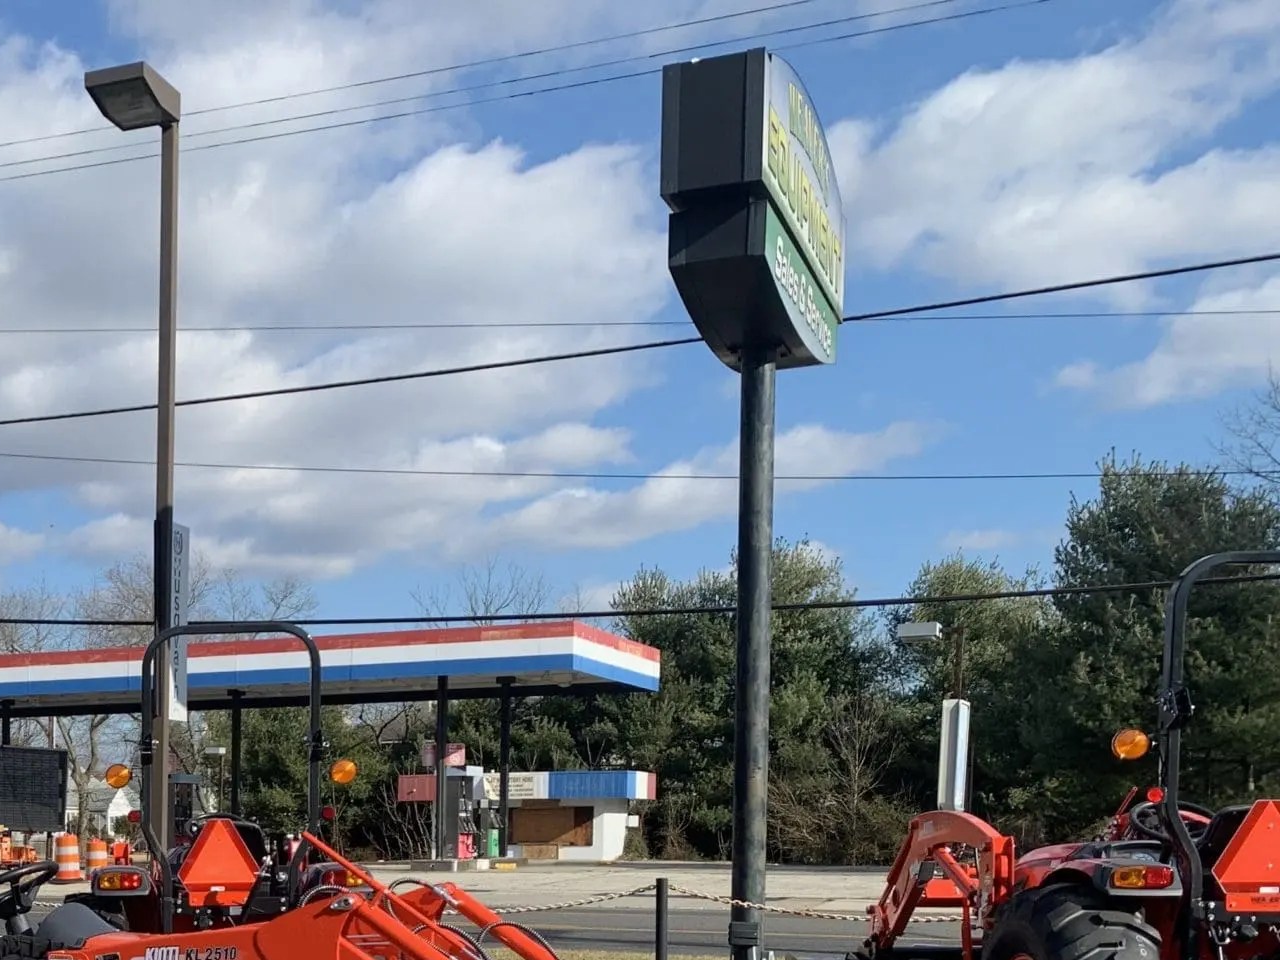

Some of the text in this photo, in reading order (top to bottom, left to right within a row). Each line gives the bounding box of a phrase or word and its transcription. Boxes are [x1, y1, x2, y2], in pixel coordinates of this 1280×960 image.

[768, 103, 841, 294] EQUIPMENT
[775, 235, 831, 358] Sales & Service
